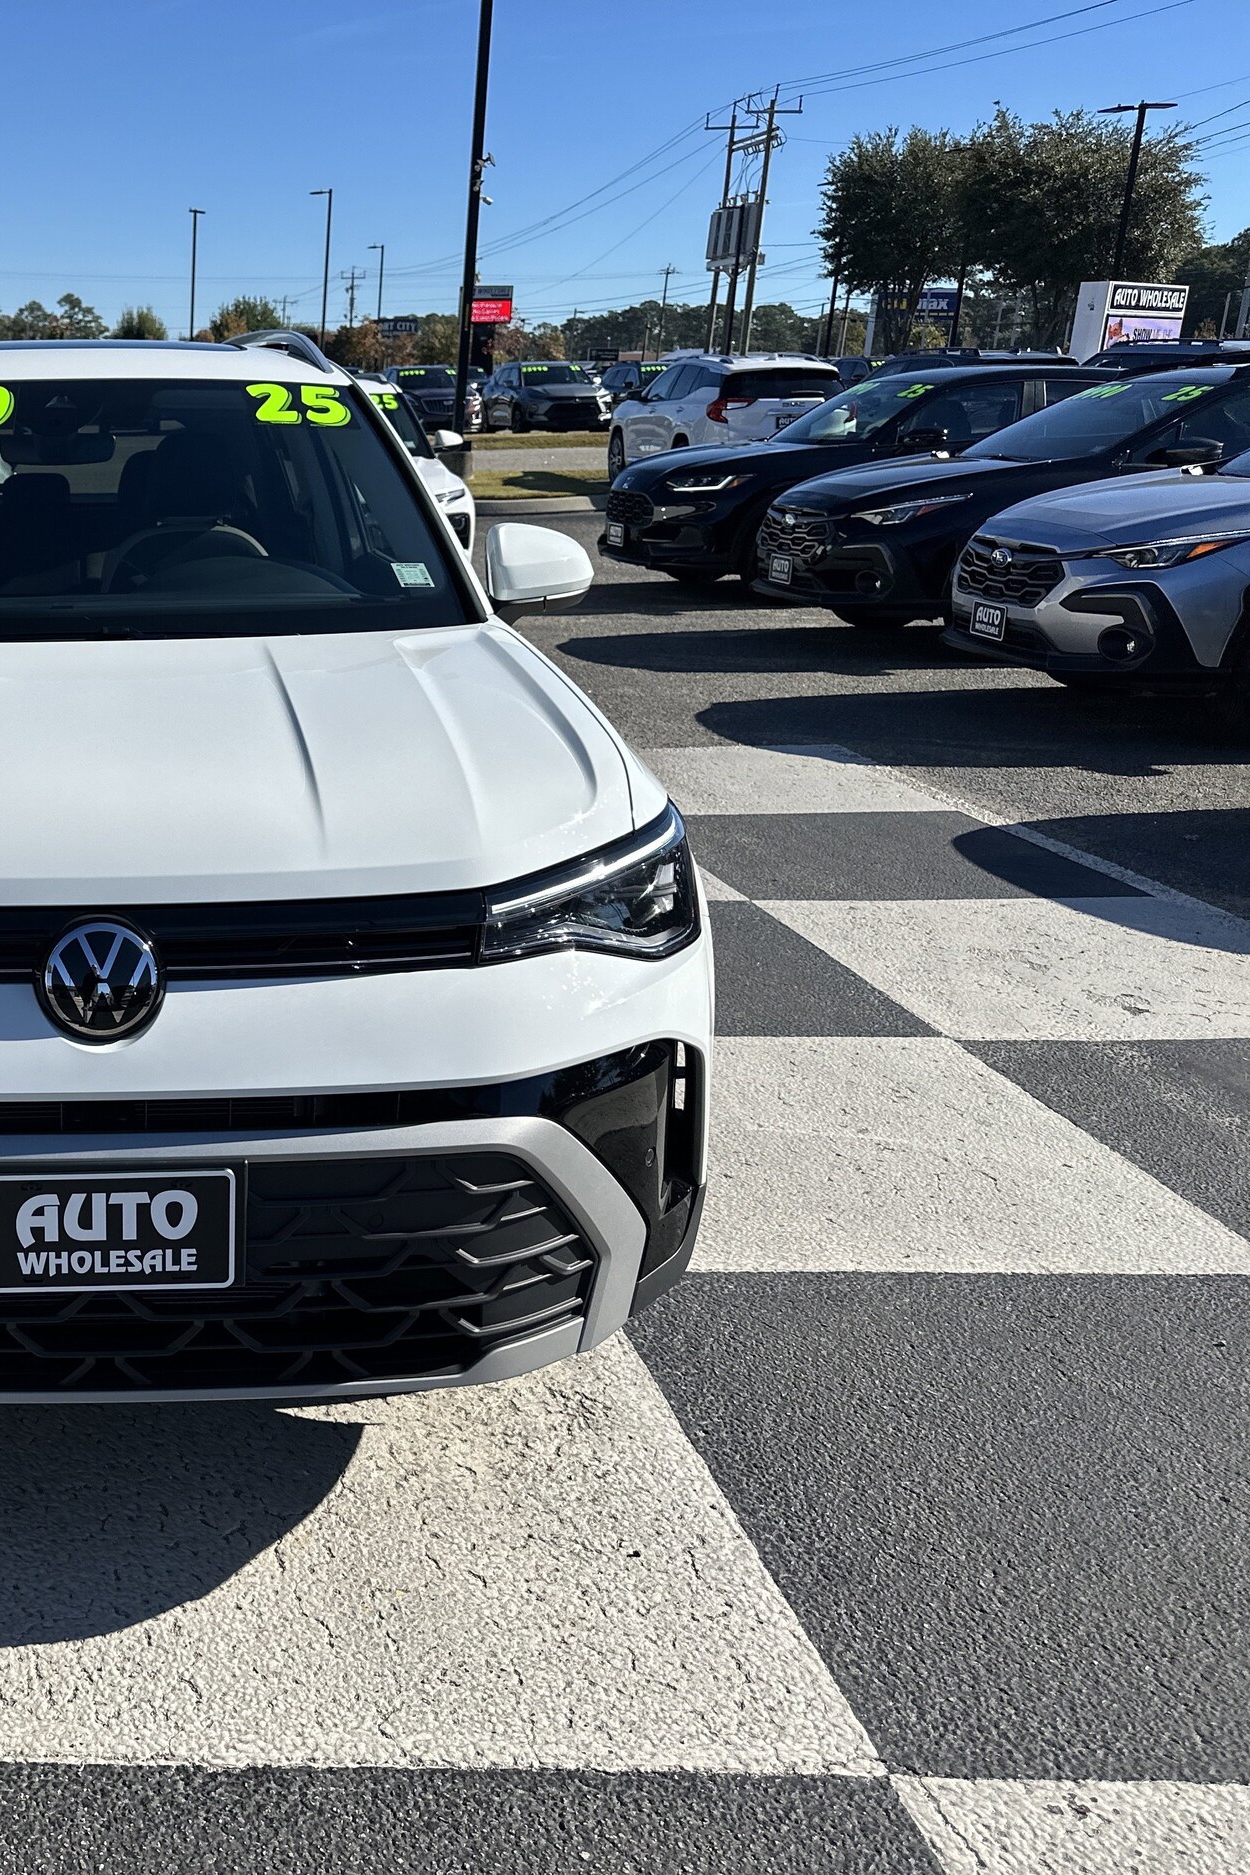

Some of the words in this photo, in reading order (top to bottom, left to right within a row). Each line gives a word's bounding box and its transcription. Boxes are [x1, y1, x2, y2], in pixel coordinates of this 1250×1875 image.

[1114, 287, 1138, 306] AUTO
[1139, 289, 1185, 309] WHOLESALE
[897, 384, 934, 398] 25
[1161, 386, 1214, 400] 25
[246, 383, 351, 426] 25
[369, 394, 399, 410] 25
[773, 558, 789, 572] AUTO
[976, 606, 1001, 625] AUTO
[16, 1190, 198, 1248] AUTO
[17, 1249, 198, 1277] WHOLESALE
